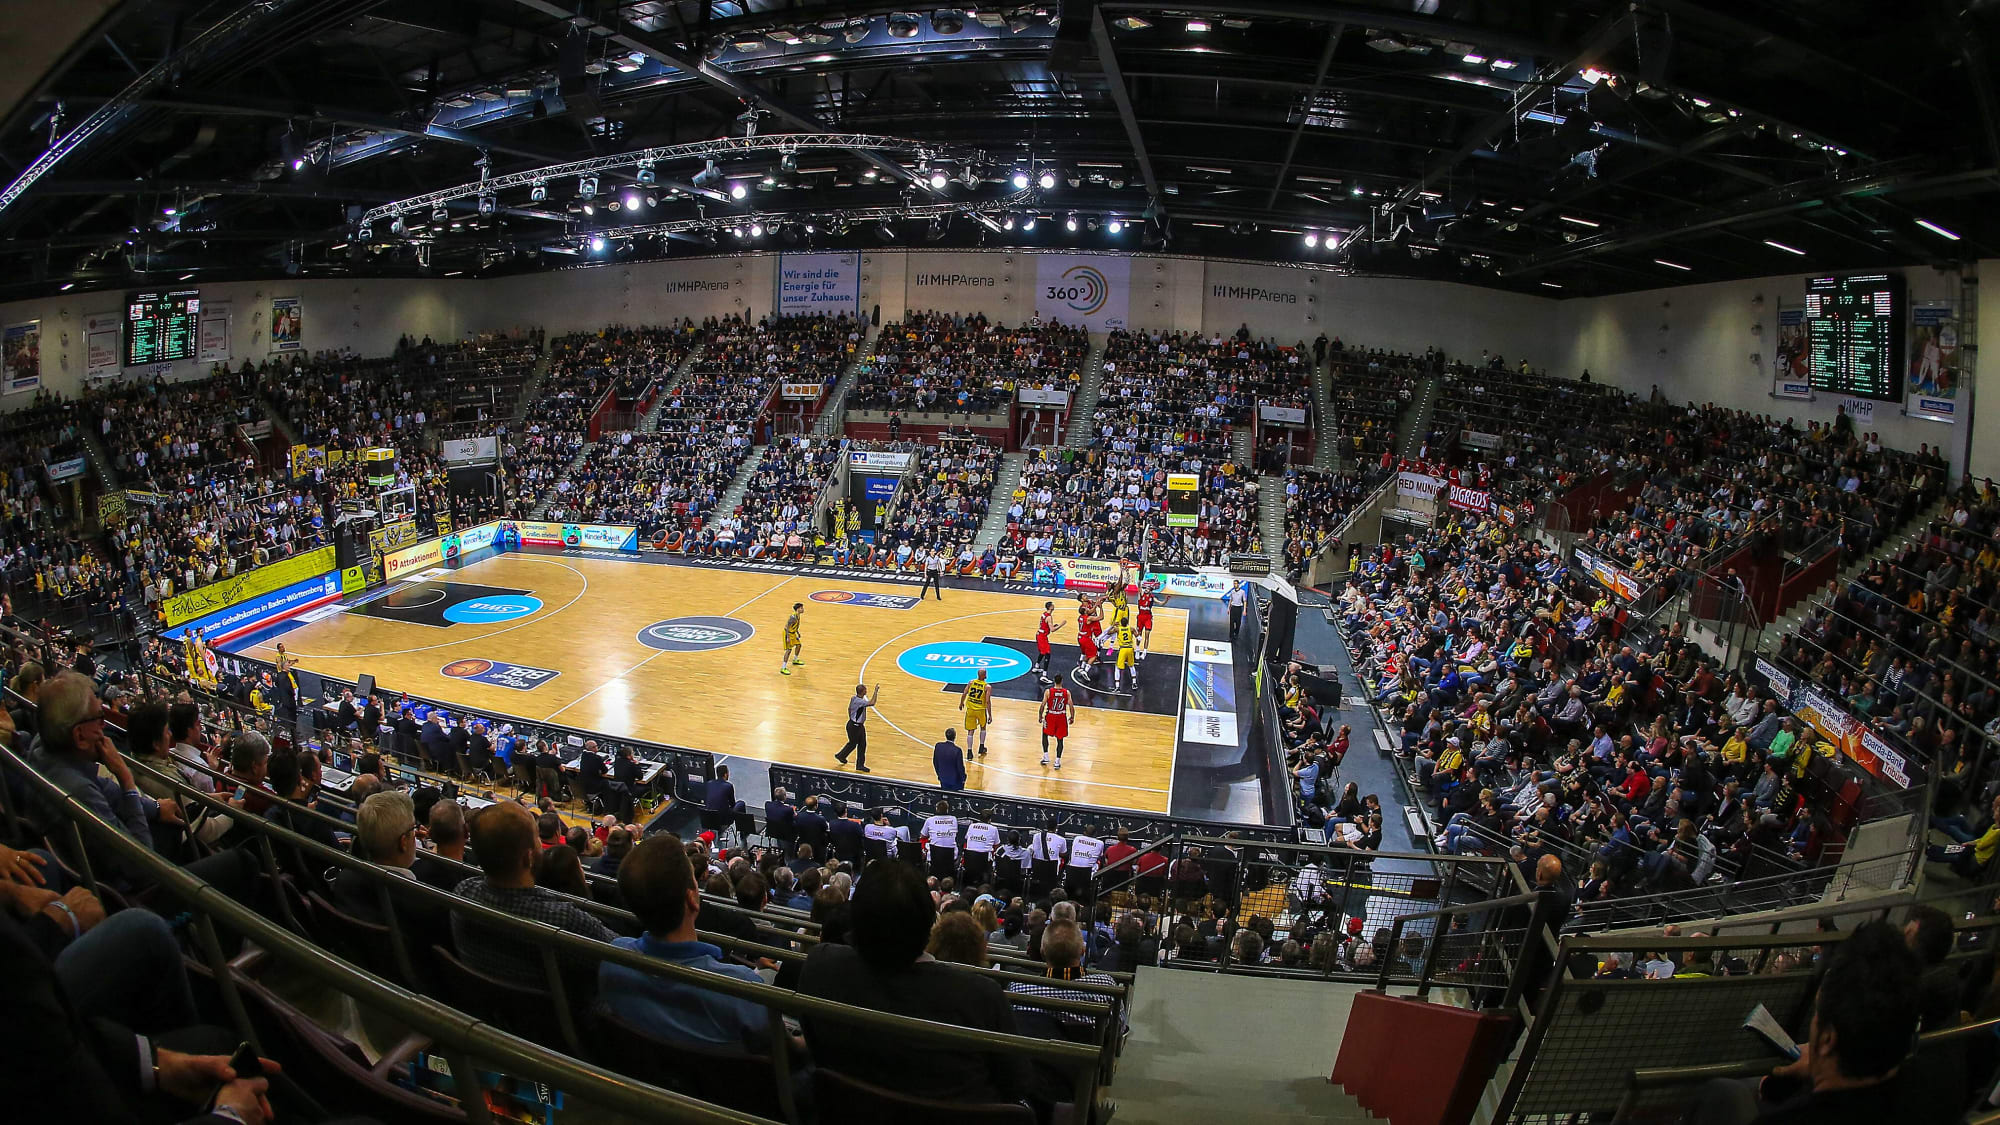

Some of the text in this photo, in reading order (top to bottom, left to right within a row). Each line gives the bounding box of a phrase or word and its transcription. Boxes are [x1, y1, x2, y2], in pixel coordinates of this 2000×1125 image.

[803, 268, 821, 278] sind
[825, 268, 839, 278] die
[677, 281, 729, 292] MHPArena
[784, 281, 836, 292] Energie für
[931, 275, 994, 286] MHPArena
[811, 293, 853, 302] Zuhause.
[1046, 287, 1086, 300] 360°
[1228, 286, 1297, 304] MHPArena
[1852, 401, 1873, 416] MHP
[1398, 478, 1415, 490] RED
[388, 549, 439, 572] 19 Attraktionen!
[1067, 560, 1111, 571] Gemeinsam
[1075, 571, 1100, 580] Großes
[1171, 577, 1225, 590] Kinder welt
[205, 621, 221, 633] beste
[222, 607, 261, 626] Gehaltskonto
[268, 585, 324, 609] Baden-Württemberg
[1123, 633, 1129, 641] 2
[924, 653, 993, 667] SWLB
[502, 665, 552, 680] BBL
[1756, 659, 1789, 687] Sparda-Bank
[969, 687, 984, 699] 27
[1052, 698, 1065, 711] 16
[1806, 693, 1842, 724] Sparda-Bank
[1206, 722, 1220, 738] MHP
[1820, 716, 1844, 739] Tribüne
[1863, 732, 1905, 771] Sparda-Bank
[1884, 763, 1909, 789] Tribüne
